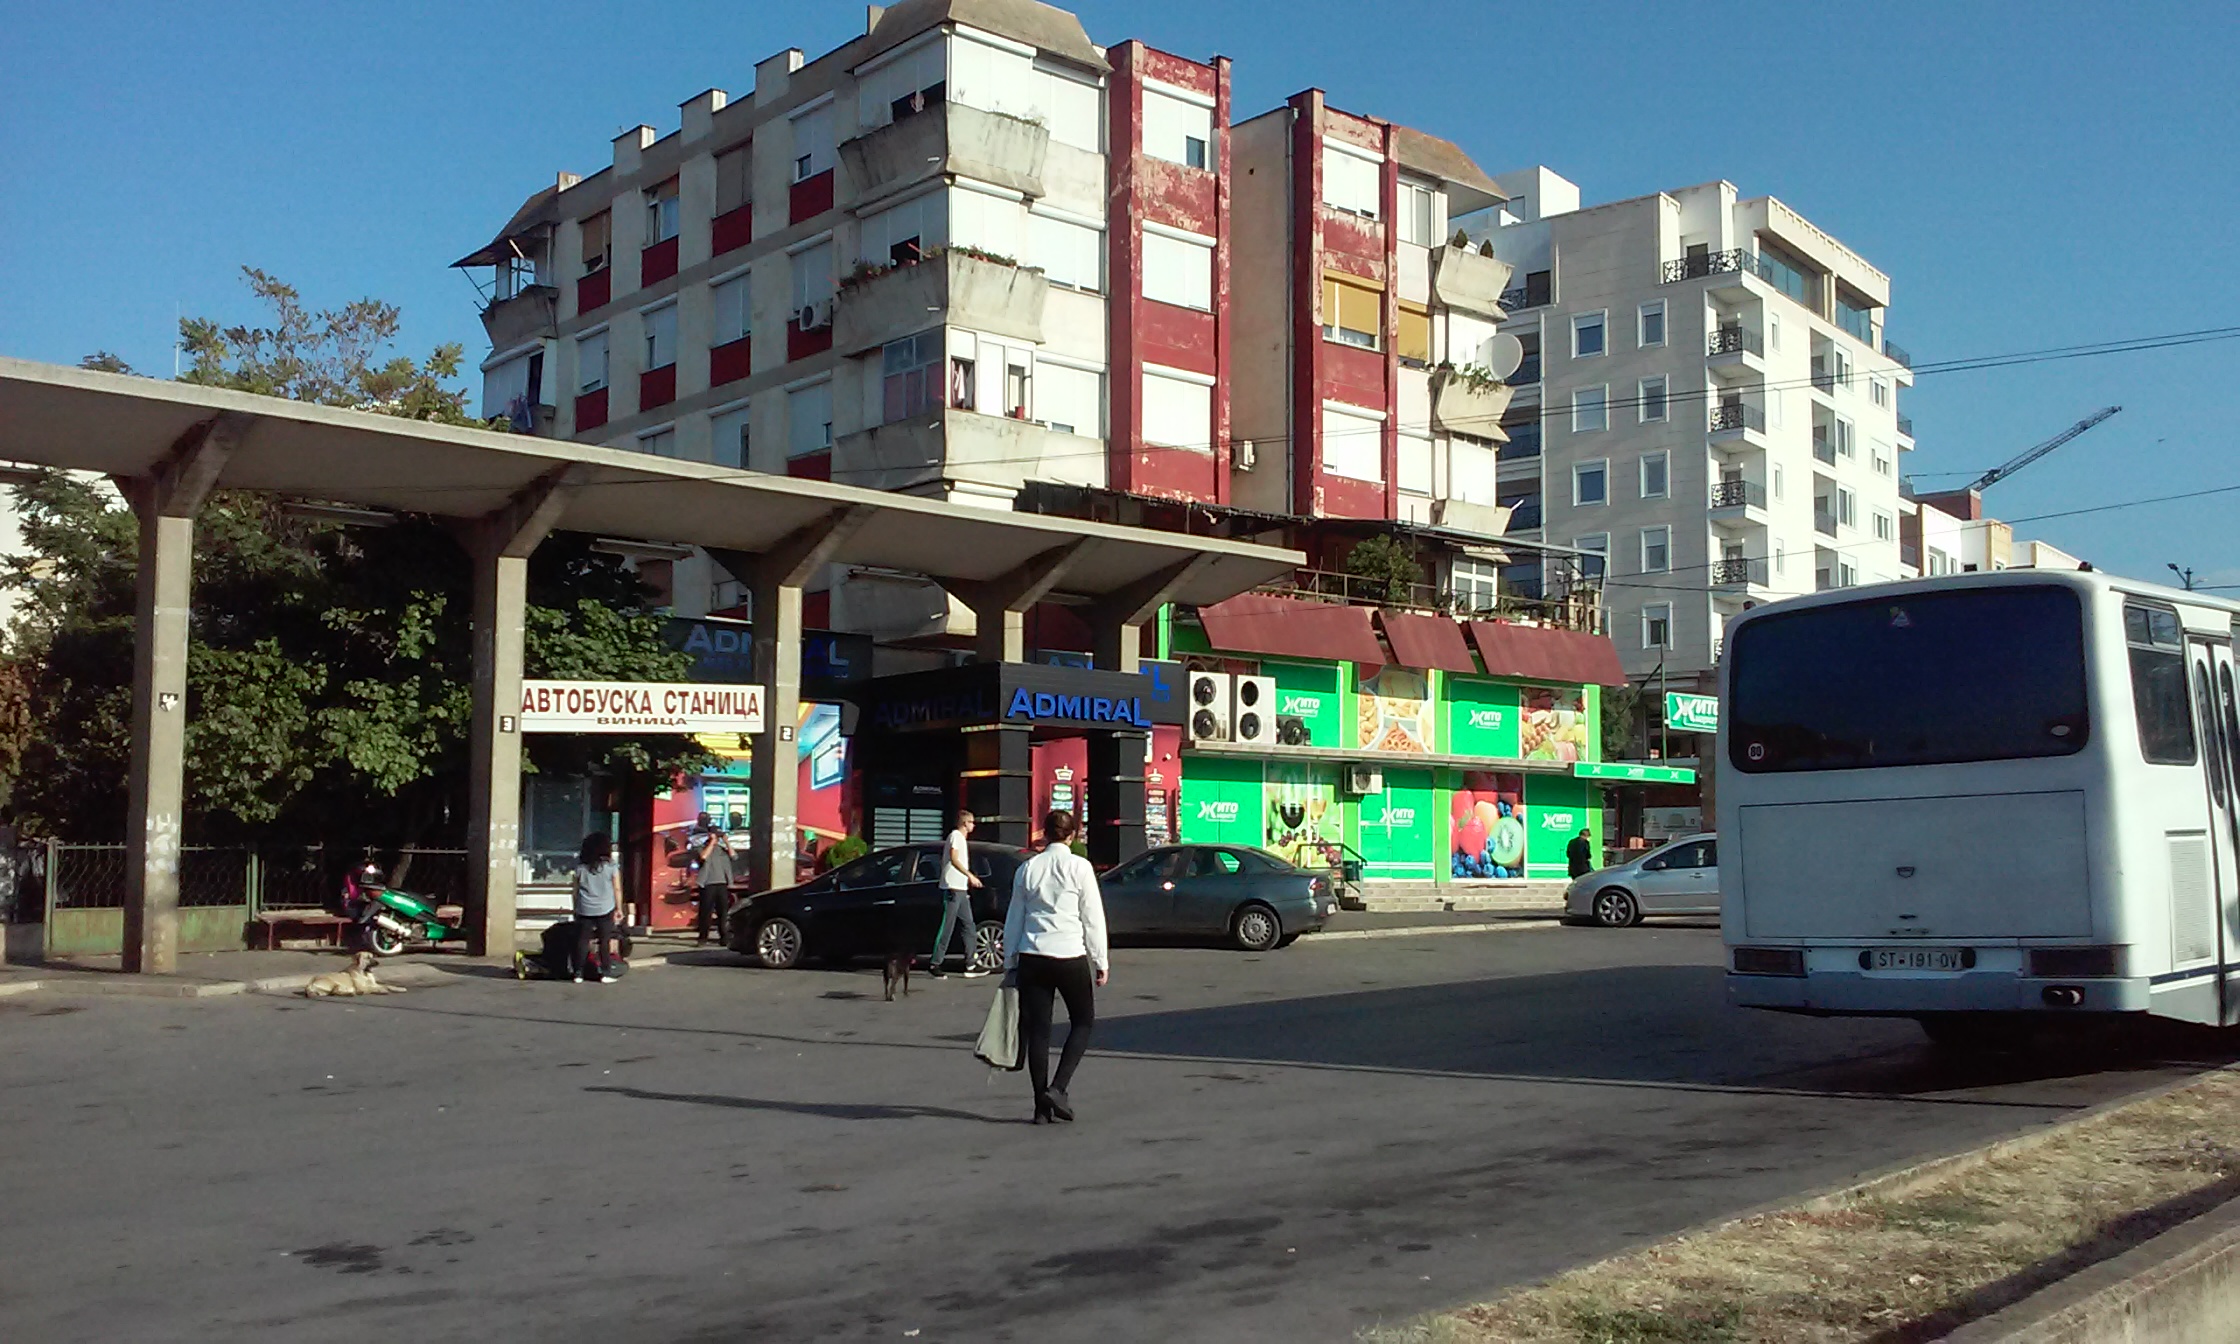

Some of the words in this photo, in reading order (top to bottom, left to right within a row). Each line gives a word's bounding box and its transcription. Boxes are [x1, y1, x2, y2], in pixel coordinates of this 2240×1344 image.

[522, 688, 652, 714] АВТОБУСКА
[664, 690, 759, 719] СТАНИЦА
[1005, 687, 1152, 727] ADMIRAL
[503, 717, 512, 731] 3
[597, 717, 687, 726] ВИНИЦА
[783, 727, 791, 740] 2
[1750, 746, 1762, 757] 80
